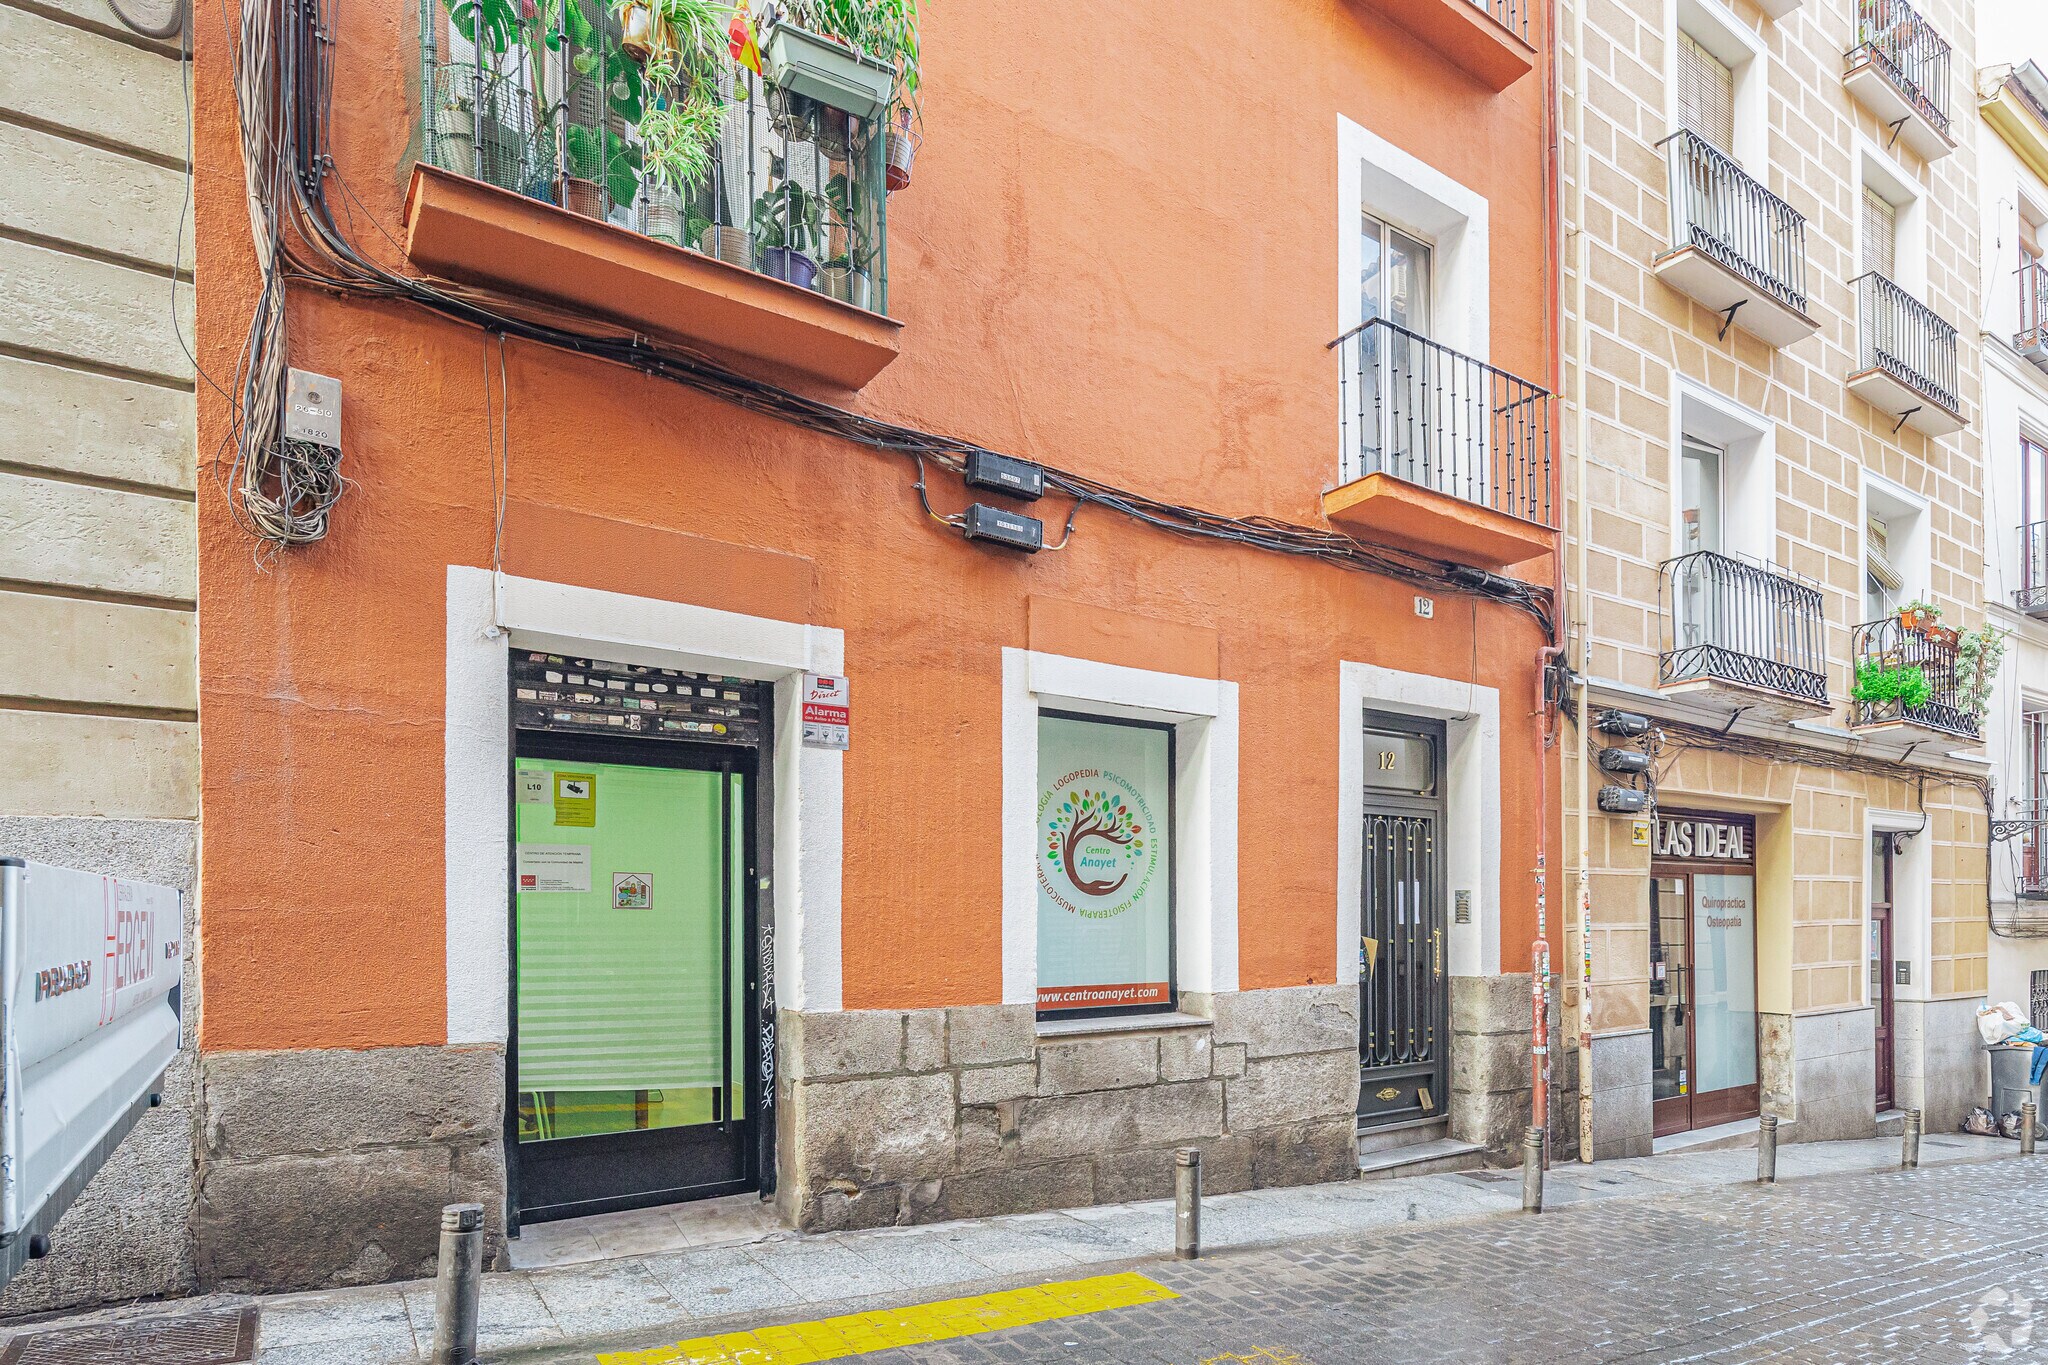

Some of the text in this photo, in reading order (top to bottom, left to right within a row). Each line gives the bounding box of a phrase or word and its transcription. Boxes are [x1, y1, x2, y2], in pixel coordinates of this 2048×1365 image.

[1418, 598, 1430, 615] 12
[810, 689, 842, 700] Direct
[805, 705, 846, 719] Alarma
[1378, 751, 1396, 770] 12
[527, 783, 542, 791] L10
[1053, 769, 1099, 791] LOGOPEDIA
[1103, 770, 1156, 834] PSICOMOTRICIDAD
[1694, 822, 1750, 859] IDEAL
[1085, 846, 1111, 855] Centro
[1080, 856, 1117, 870] Anayet
[1079, 899, 1132, 919] FISIOTERAPIA
[1702, 895, 1746, 911] Quiropráctica
